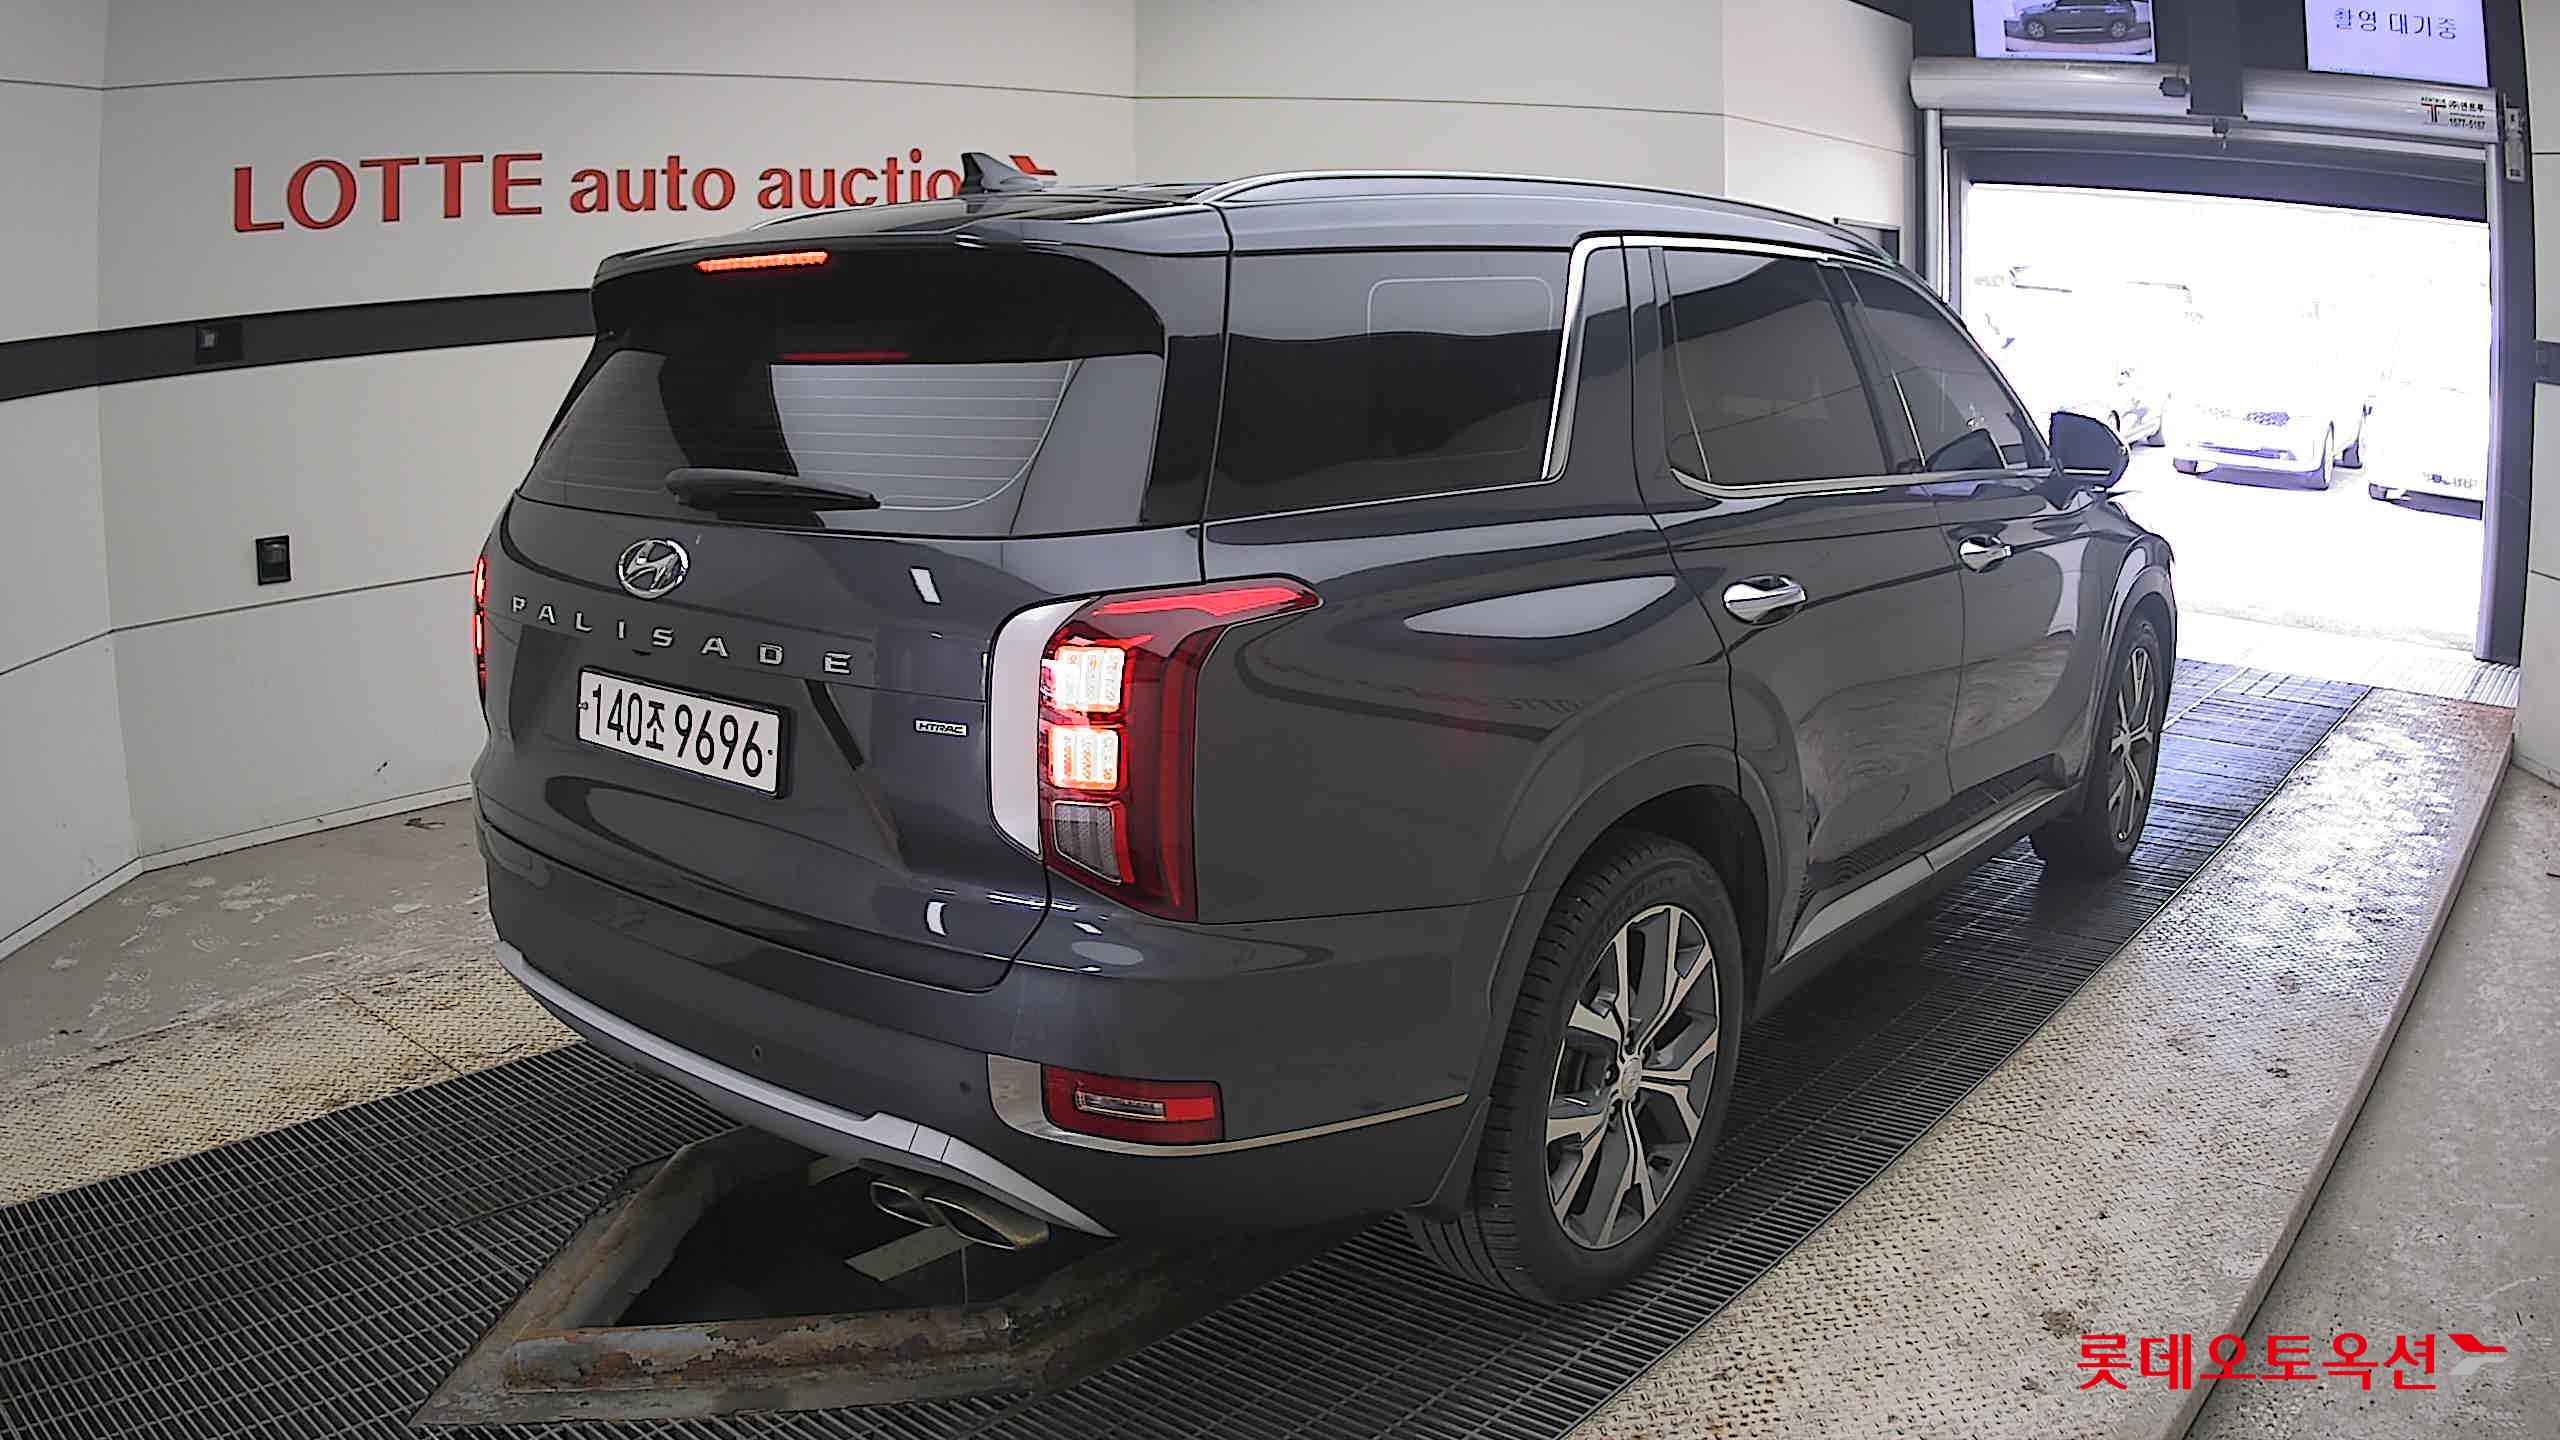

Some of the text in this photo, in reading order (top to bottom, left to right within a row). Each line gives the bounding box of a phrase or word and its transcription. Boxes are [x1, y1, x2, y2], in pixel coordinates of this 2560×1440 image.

[235, 149, 963, 232] LOTTE auto auctio
[511, 596, 852, 675] PALISADE
[591, 683, 763, 778] 140조 9696
[916, 720, 967, 735] HTRAC
